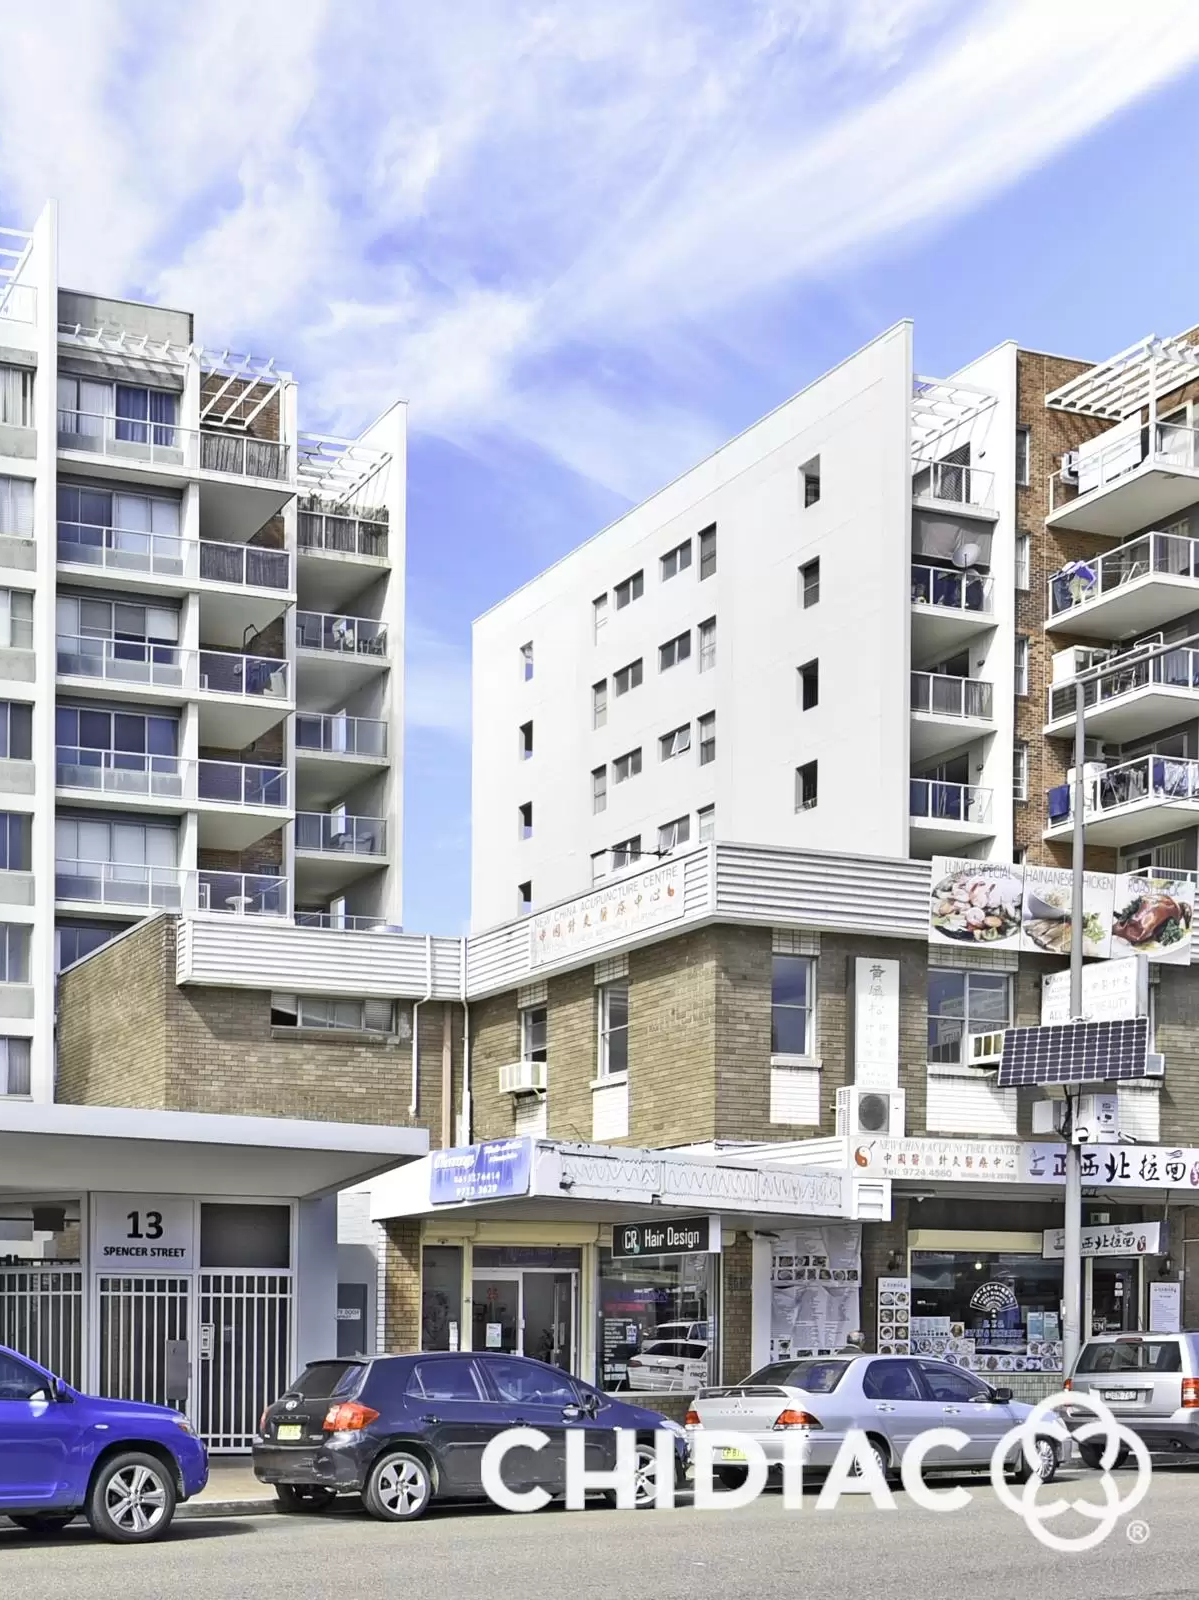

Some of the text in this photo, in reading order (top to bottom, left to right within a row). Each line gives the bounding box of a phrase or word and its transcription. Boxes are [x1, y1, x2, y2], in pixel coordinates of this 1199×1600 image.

[945, 860, 1011, 879] LUNCH SPECIAL
[1083, 874, 1114, 890] HICKEN
[554, 905, 578, 921] CHINA
[581, 881, 638, 912] ACUPUNCTURE
[643, 865, 678, 888] CENTRE
[127, 1211, 163, 1239] 13
[645, 1229, 664, 1247] Hair
[667, 1227, 700, 1248] Design
[103, 1246, 186, 1257] SPENCER STREET
